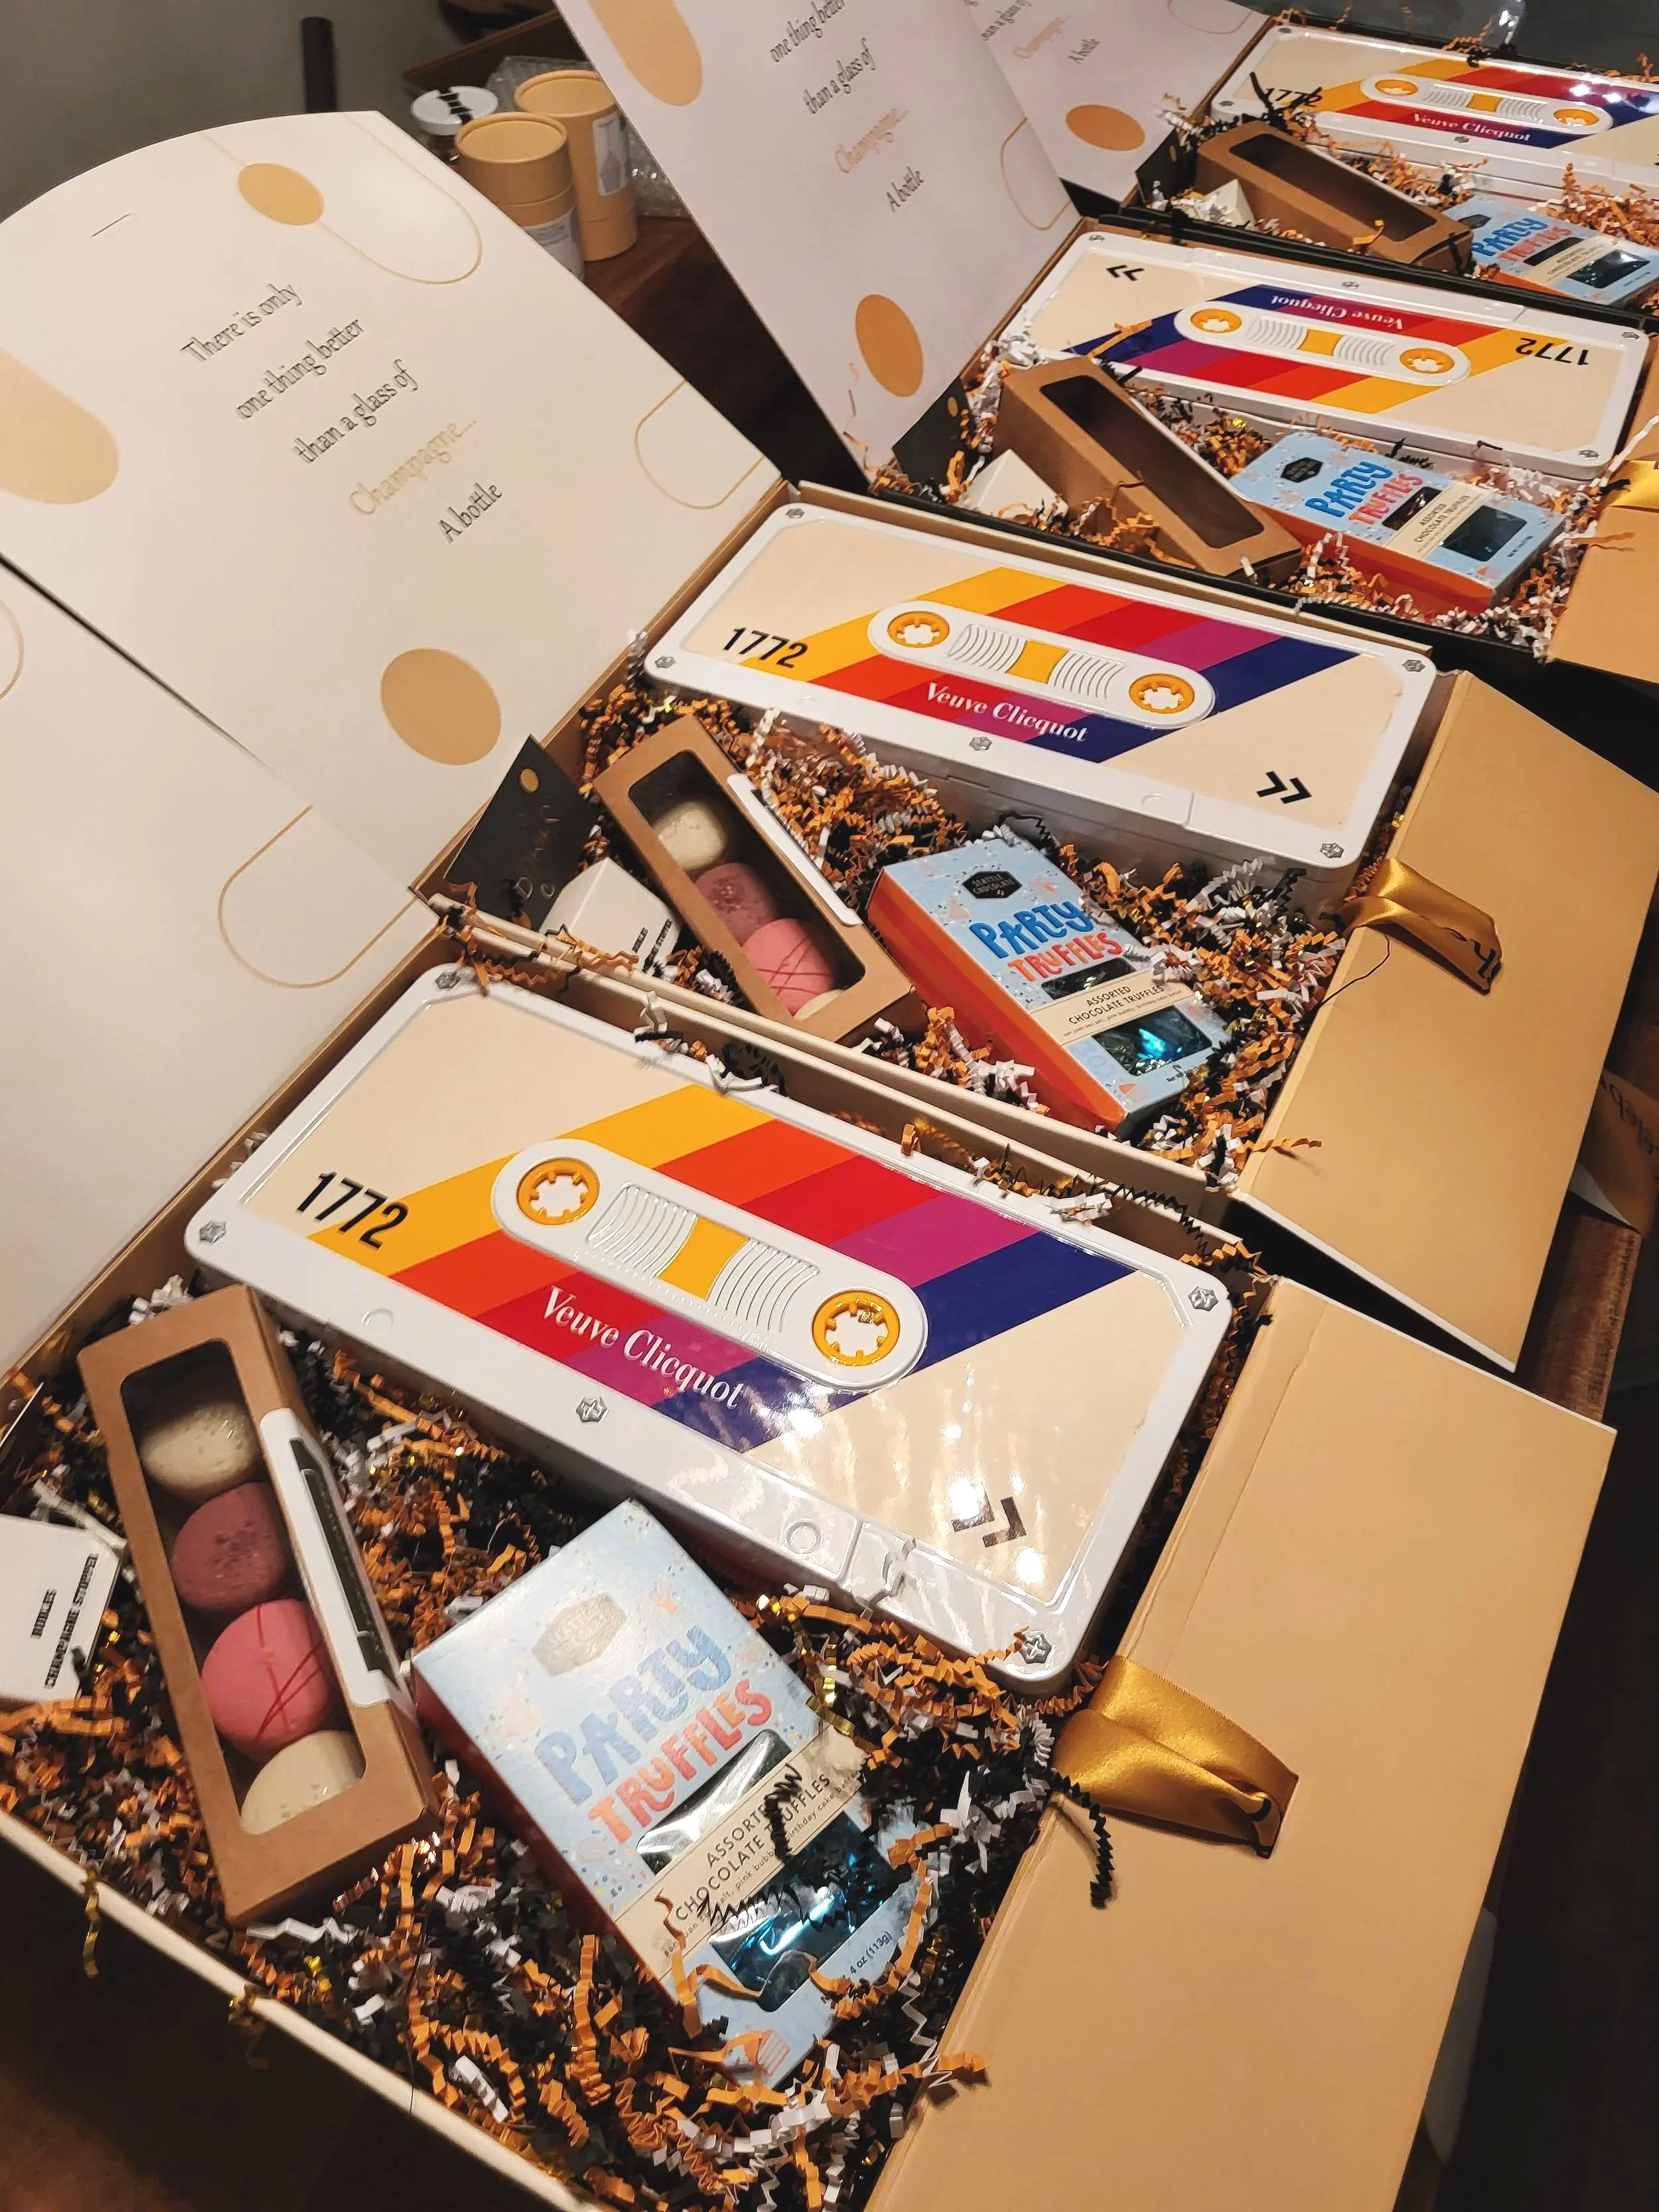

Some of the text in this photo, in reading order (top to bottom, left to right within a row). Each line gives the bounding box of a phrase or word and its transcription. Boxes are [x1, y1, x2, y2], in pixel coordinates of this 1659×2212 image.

[770, 38, 792, 62] one
[787, 15, 823, 46] thing
[803, 88, 833, 114] than
[830, 80, 841, 94] a
[861, 37, 876, 71] of
[1413, 113, 1532, 142] Veuve Clicquot
[886, 165, 924, 212] A bottle
[1472, 218, 1550, 256] PARTY
[180, 283, 303, 362] There is only
[1270, 294, 1404, 331] Veuve Clicquot
[236, 319, 364, 419] one thing better
[1516, 336, 1590, 366] 1772
[293, 358, 419, 464] than a glass of
[437, 482, 503, 544] A bottle
[1305, 461, 1394, 518] PARTY
[722, 627, 809, 669] 1772
[924, 682, 1090, 743] Veuve Clicquot
[969, 901, 1094, 959] PARTY
[1007, 932, 1122, 982] TRUFFLES
[1068, 999, 1124, 1025] CHOCOLATE
[1123, 985, 1165, 1004] TRUFFLES
[1086, 986, 1131, 1007] ASSORTED
[295, 1171, 409, 1251] 1772
[543, 1285, 745, 1410] Veuve Clicquot
[535, 1625, 733, 1806] PARTY
[588, 1678, 773, 1846] TRUFFLES
[706, 1801, 770, 1869] ASSORTE
[735, 1872, 754, 1890] pink
[817, 1793, 835, 1811] cake
[675, 1834, 765, 1921] CHOCOLATE
[849, 1931, 892, 1975] 4 oz (113g)
